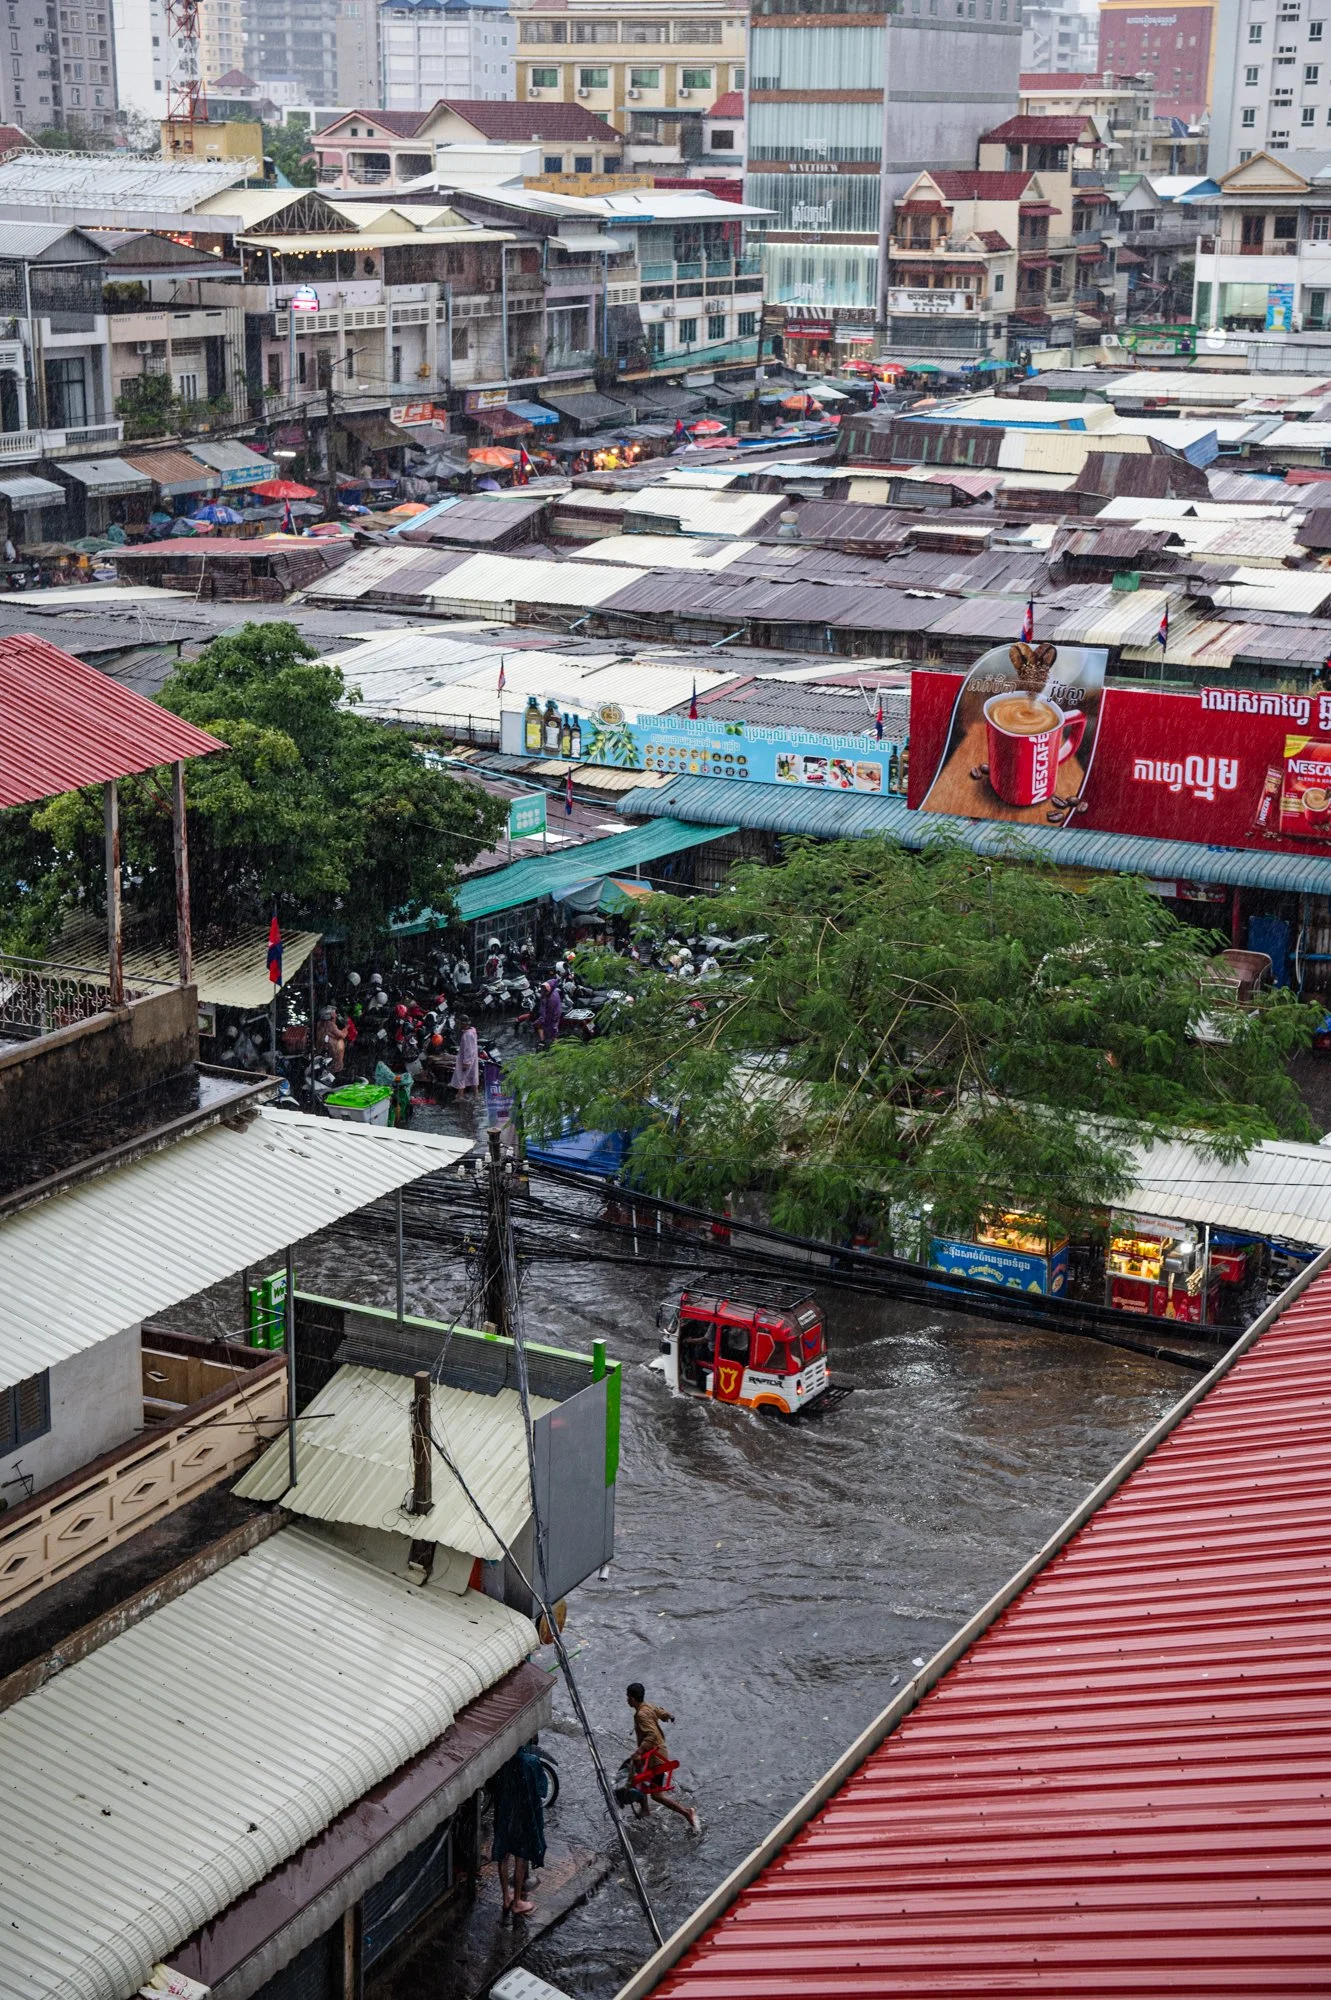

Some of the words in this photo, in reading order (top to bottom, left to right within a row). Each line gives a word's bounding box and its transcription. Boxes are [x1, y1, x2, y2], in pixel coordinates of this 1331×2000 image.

[788, 163, 838, 172] MATTHEW
[1029, 732, 1051, 805] NESCAFÉ
[749, 1376, 784, 1389] RAPTOR
